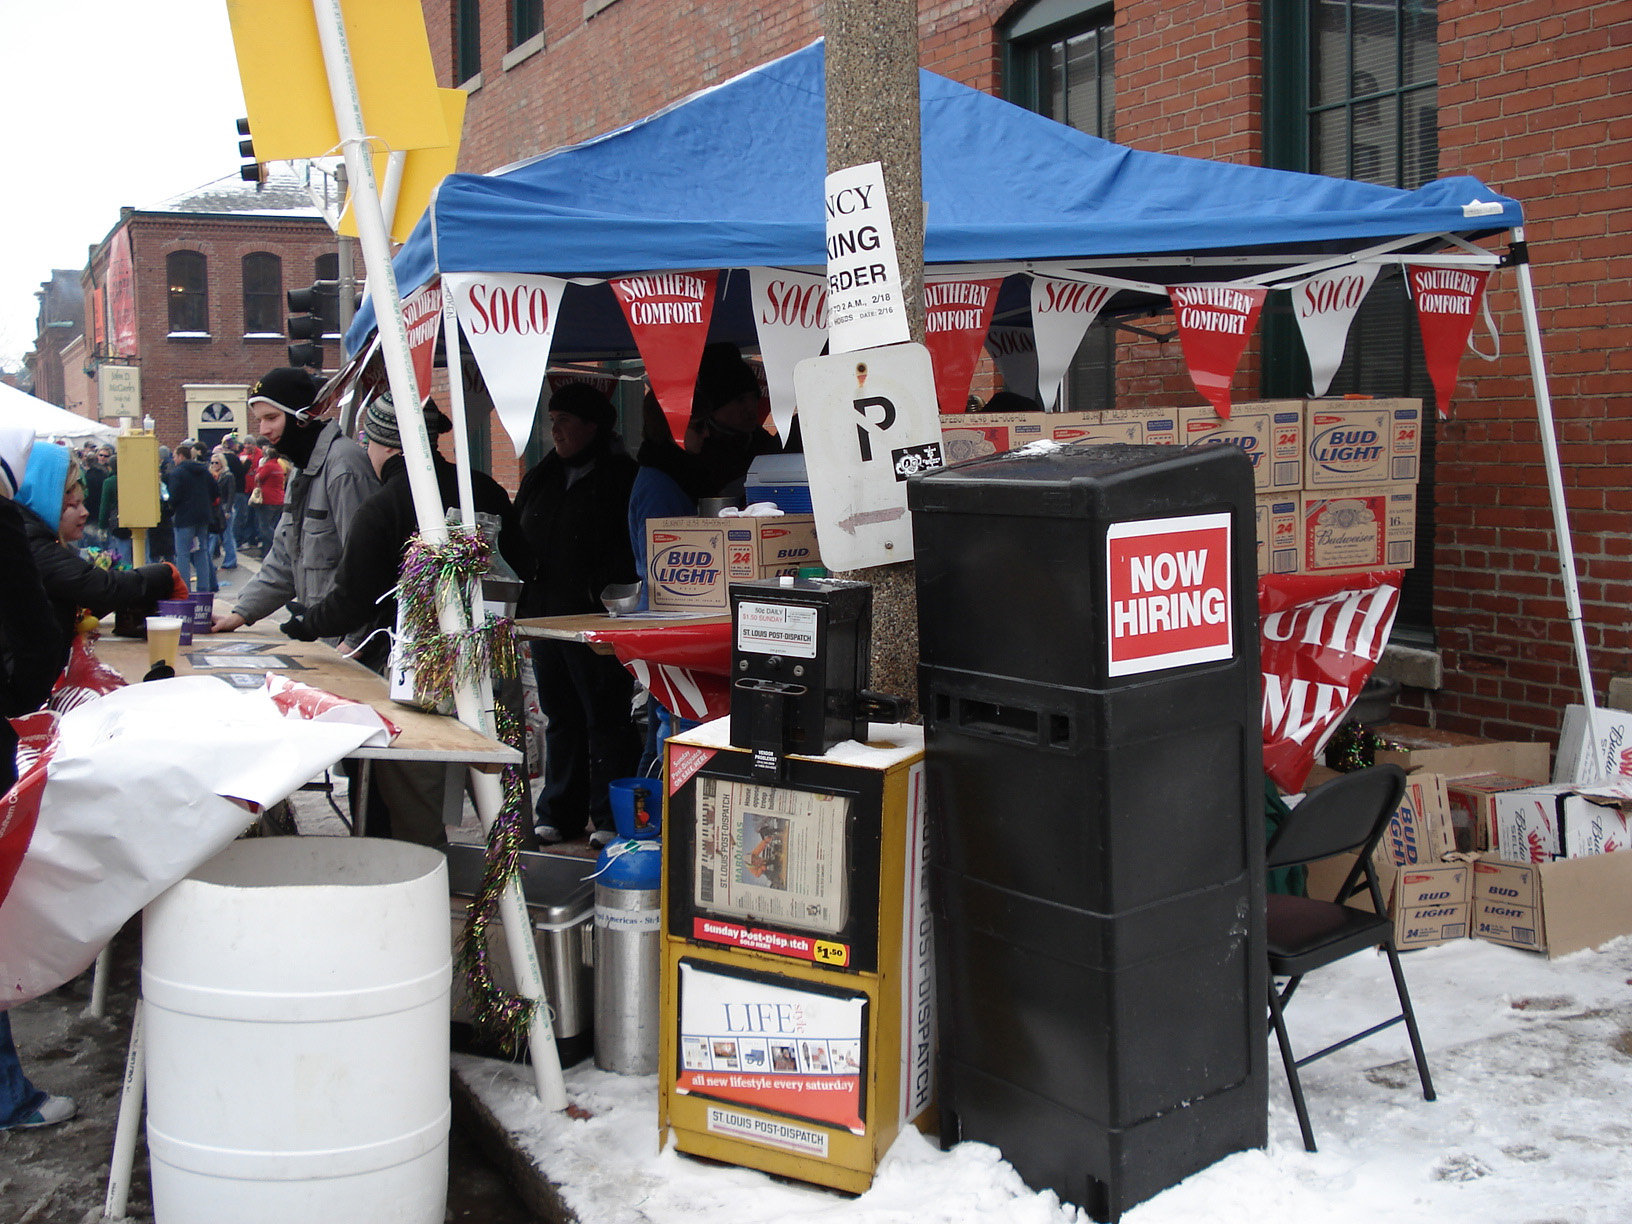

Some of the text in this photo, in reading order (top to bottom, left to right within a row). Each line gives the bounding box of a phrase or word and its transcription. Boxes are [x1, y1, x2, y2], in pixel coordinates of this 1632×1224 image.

[619, 274, 707, 302] SOUTHERN
[827, 263, 887, 297] RDER
[1415, 270, 1480, 296] SOUTHERN
[872, 293, 891, 304] 2/18
[924, 282, 990, 308] OUTHERN
[1038, 282, 1109, 314] SOCO
[1175, 287, 1254, 315] SOUTHERN
[1302, 275, 1364, 318] SOCO
[1418, 292, 1473, 315] COMFORT
[469, 283, 548, 335] SOCO
[630, 301, 703, 326] COMFORT
[878, 307, 894, 316] 2/16
[1181, 307, 1247, 335] COMFORT
[853, 396, 895, 462] P
[1397, 430, 1416, 441] 24
[1278, 433, 1297, 446] 24
[1329, 430, 1379, 447] BUD
[1319, 446, 1385, 463] LIGHT
[1276, 523, 1293, 535] 24
[1390, 516, 1401, 527] 16
[1316, 529, 1376, 546] Budweiser
[667, 551, 714, 567] BUD
[731, 552, 751, 564] 24
[777, 548, 809, 559] BUD
[659, 568, 721, 584] LIGHT
[775, 569, 798, 578] LIG
[1130, 549, 1208, 594] NOW
[758, 614, 783, 623] SUNDAY
[1114, 587, 1225, 638] HIRING
[751, 629, 767, 637] LOUIS
[769, 631, 812, 642] POST-DISPATCH
[671, 749, 702, 780] Post-Dispatch
[673, 750, 691, 767] Sunday
[674, 752, 708, 787] ON SALE HERE
[744, 787, 752, 807] House
[760, 791, 768, 809] troop
[721, 794, 730, 855] POST-DISPATCH
[1390, 811, 1407, 867] IGHT
[1401, 806, 1418, 865] BUD
[721, 855, 729, 877] LOUIS
[1418, 891, 1451, 901] BUD
[1488, 886, 1519, 897] BUD
[606, 914, 638, 924] Americas
[1414, 908, 1458, 918] LIGHT
[1484, 906, 1524, 918] LIGHT
[703, 923, 739, 939] Sunday
[1406, 929, 1419, 939] 24
[1480, 923, 1491, 932] 24
[740, 938, 771, 950] SOLD HERE
[817, 946, 843, 959] $1.50
[722, 1003, 796, 1034] LIFE
[795, 1004, 807, 1034] style
[692, 1075, 854, 1092] all new lifestyle every saturday
[712, 1110, 824, 1146] ST. LOUIS POST-DISPATCH
